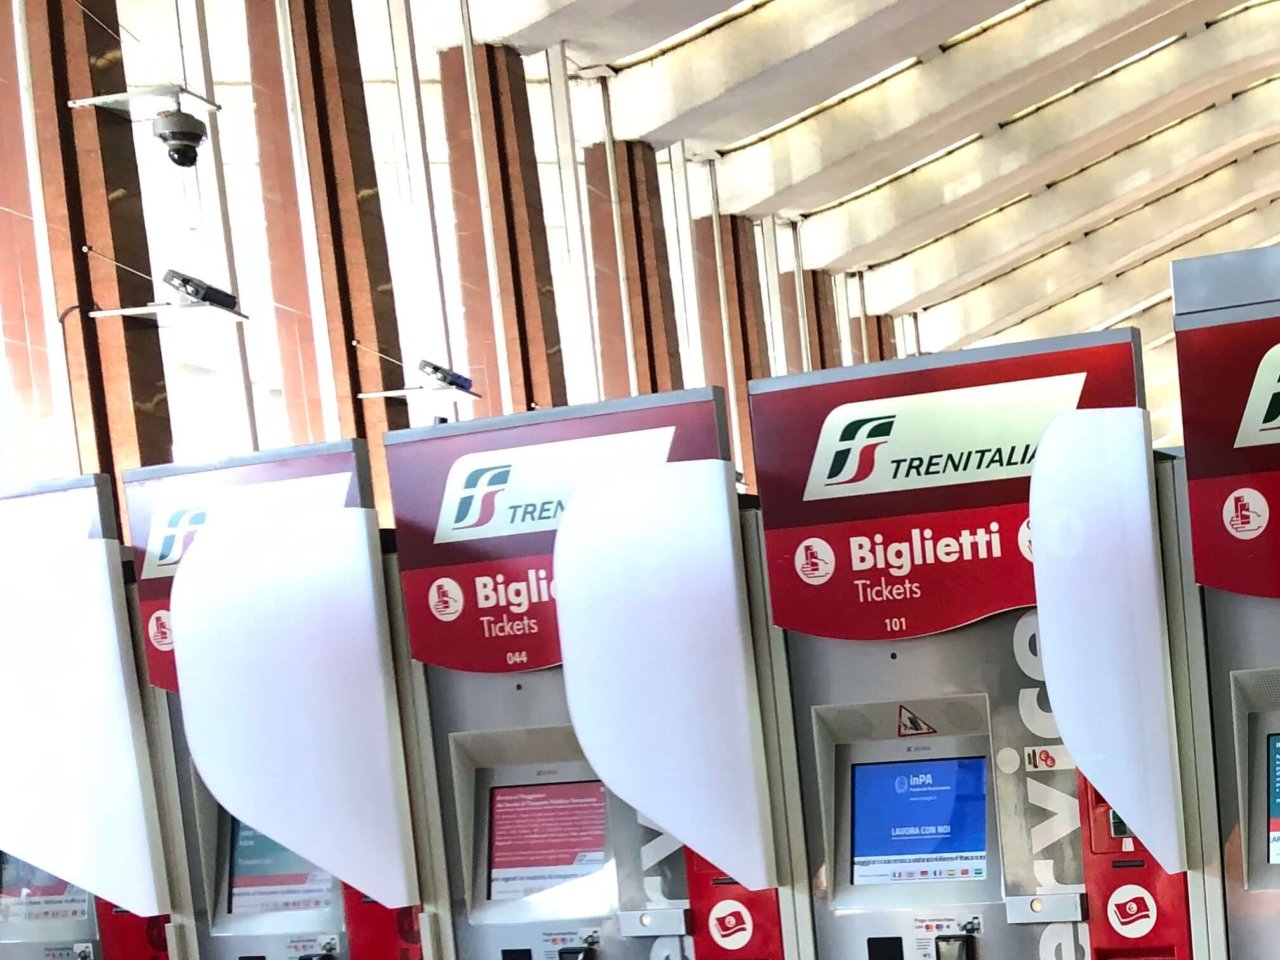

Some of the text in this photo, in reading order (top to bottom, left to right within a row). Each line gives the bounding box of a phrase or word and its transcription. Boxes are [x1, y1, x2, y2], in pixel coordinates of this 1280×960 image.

[849, 521, 1002, 576] Biglietti
[853, 577, 922, 603] Tickets
[479, 613, 538, 638] Tickets
[884, 617, 906, 632] 101
[506, 652, 528, 664] 044
[909, 773, 933, 785] inPA
[891, 825, 951, 836] LAVORA CON NOI
